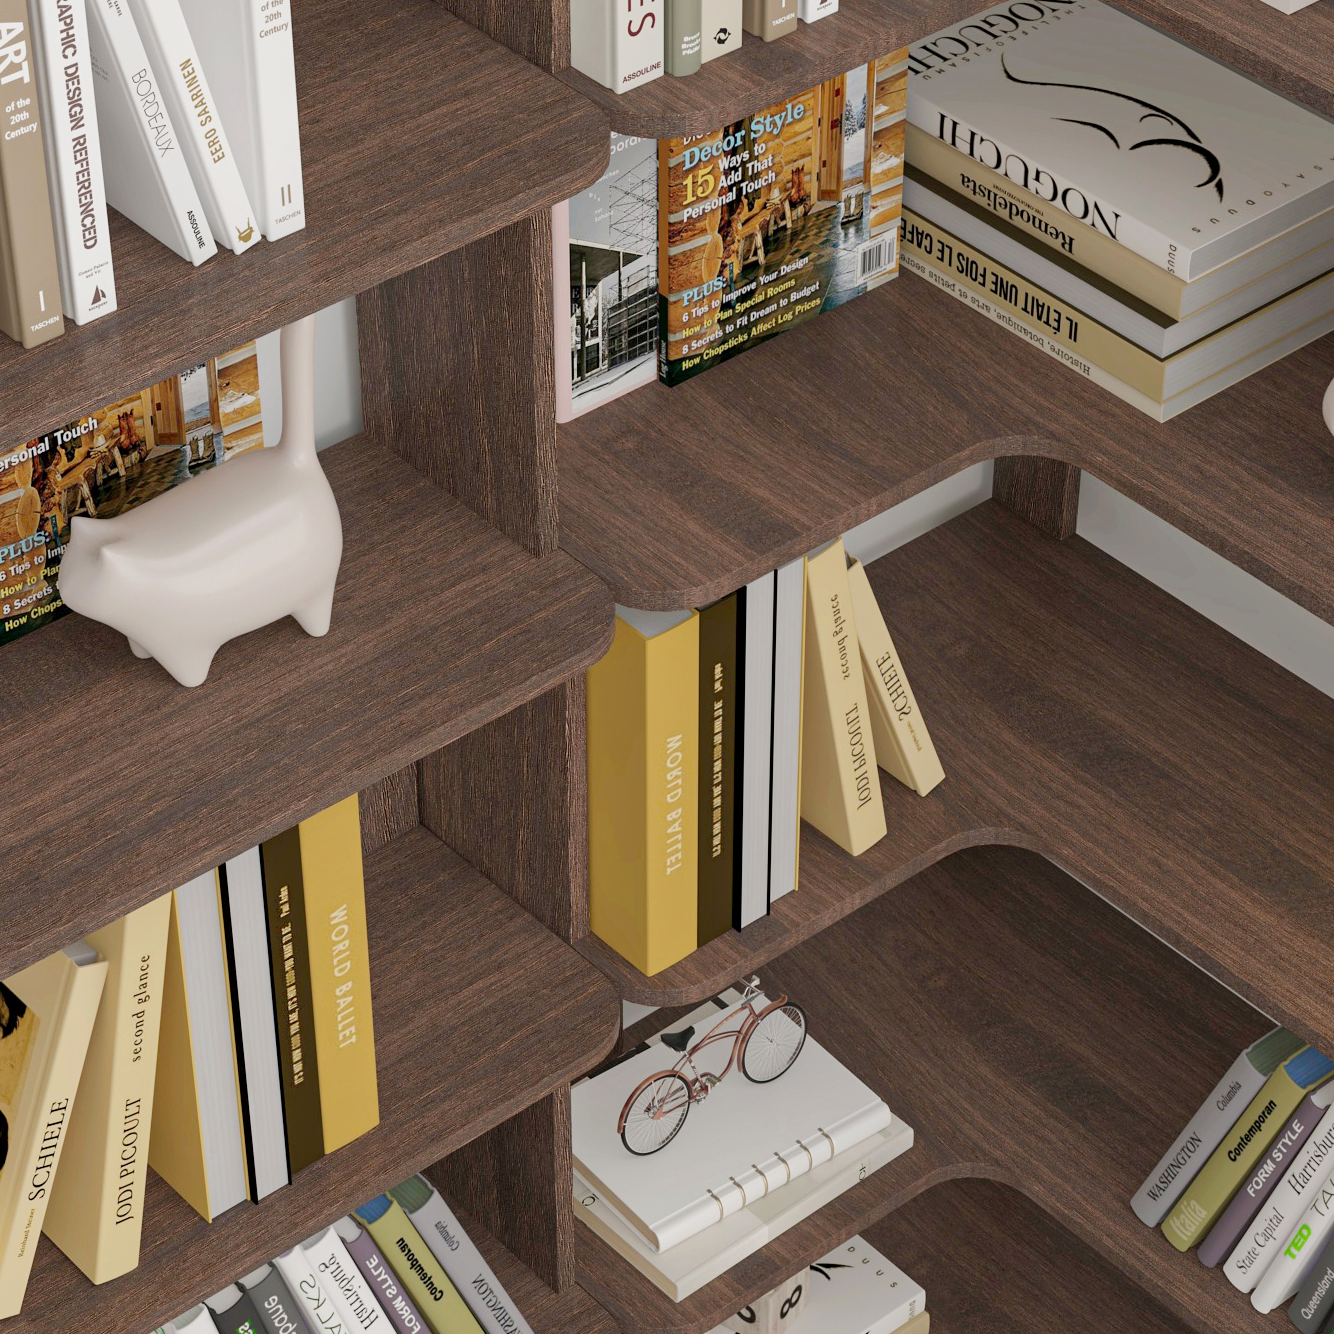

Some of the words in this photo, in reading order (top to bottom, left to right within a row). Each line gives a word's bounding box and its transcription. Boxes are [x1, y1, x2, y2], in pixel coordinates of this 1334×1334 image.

[5, 101, 15, 113] of
[16, 98, 30, 110] the
[10, 111, 29, 125] 20th
[64, 62, 85, 132] DESIGN
[131, 68, 174, 158] BORDEAUX
[179, 58, 212, 127] SAARINEN
[5, 122, 38, 140] Century
[205, 128, 225, 164] EERO
[683, 129, 745, 171] Decor
[751, 103, 804, 139] Style
[72, 134, 97, 250] REFERENCED
[683, 164, 715, 205] 15
[718, 149, 749, 172] Ways
[754, 143, 765, 155] to
[684, 187, 736, 223] Personal
[741, 170, 776, 195] Touch
[718, 168, 741, 190] Add
[747, 154, 773, 175] That
[937, 111, 1121, 241] NOGUCHI
[961, 173, 1075, 256] Remodelista
[682, 276, 727, 307] PLUS:
[683, 313, 688, 322] 6
[691, 305, 708, 321] Tips
[712, 299, 719, 310] to
[723, 281, 756, 303] Improve
[759, 272, 778, 285] Your
[781, 257, 808, 275] Design
[54, 417, 98, 444] Touch
[330, 903, 351, 977] WORLD
[133, 955, 150, 1004] glance
[132, 1009, 145, 1062] second
[335, 981, 357, 1049] BALLET
[1217, 1081, 1242, 1111] Columbia
[28, 1098, 69, 1201] SCHIELE
[120, 1098, 141, 1179] PICOULT
[1147, 1132, 1202, 1202] WASHINGTON
[1247, 1159, 1276, 1197] FORM
[1273, 1119, 1304, 1162] STYLE
[116, 1181, 134, 1225] JODI
[1170, 1199, 1208, 1241] Italia
[1236, 1244, 1259, 1275] State
[1254, 1207, 1285, 1248] Capital
[1284, 1223, 1311, 1260] TED
